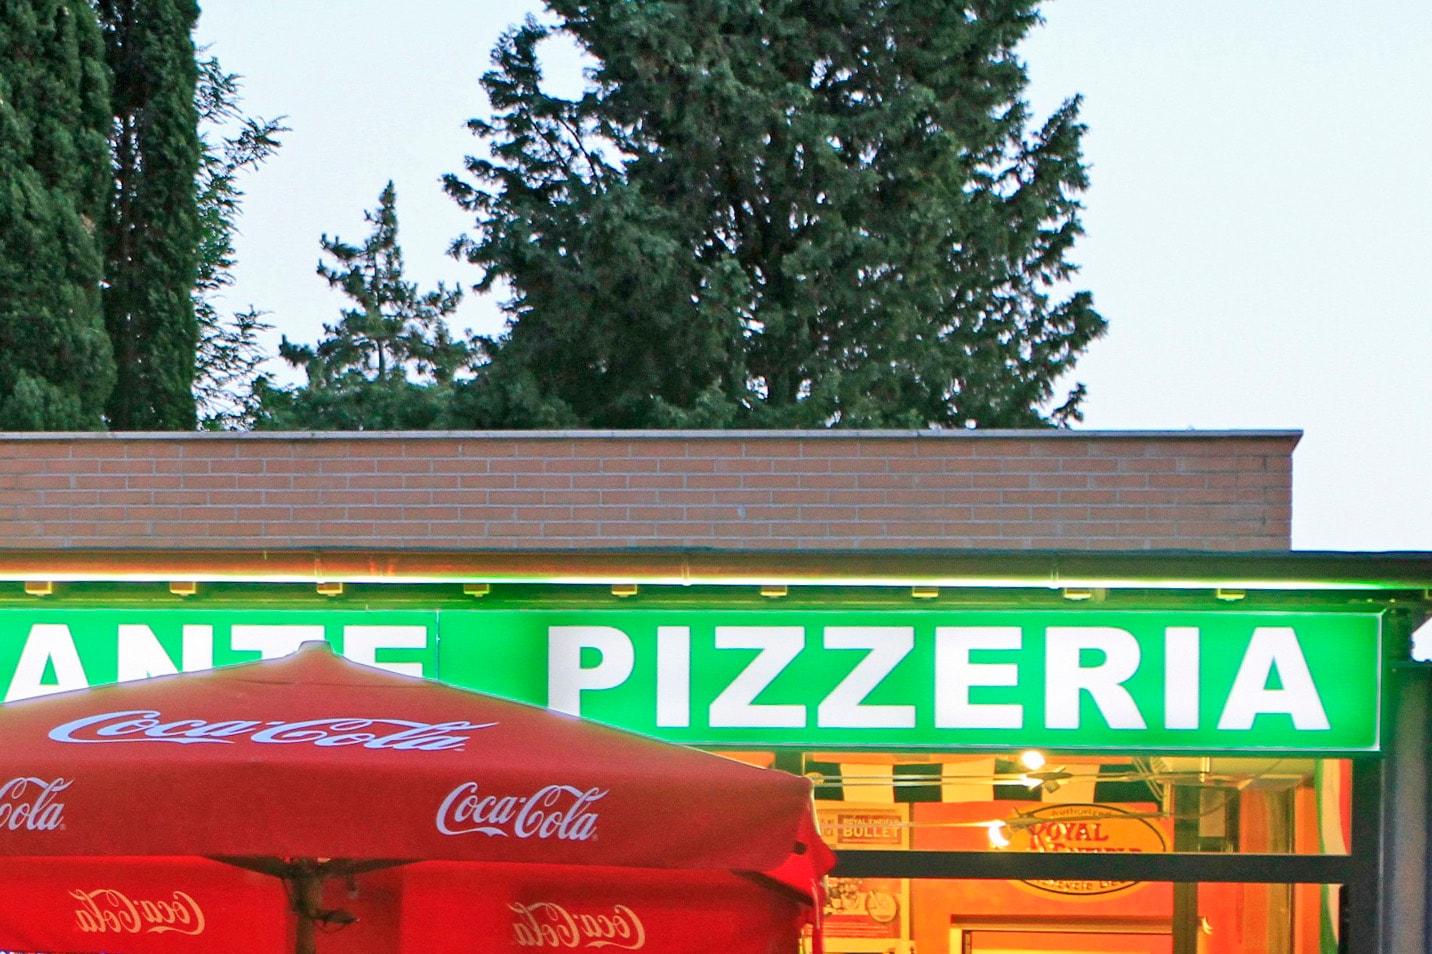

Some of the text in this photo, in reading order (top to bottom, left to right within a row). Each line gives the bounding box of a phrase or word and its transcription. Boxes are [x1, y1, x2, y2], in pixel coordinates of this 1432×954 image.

[547, 624, 1331, 731] PIZZERIA
[48, 709, 498, 752] Coca-Cola
[436, 781, 610, 841] Coca-Cola
[843, 826, 901, 838] BULLET
